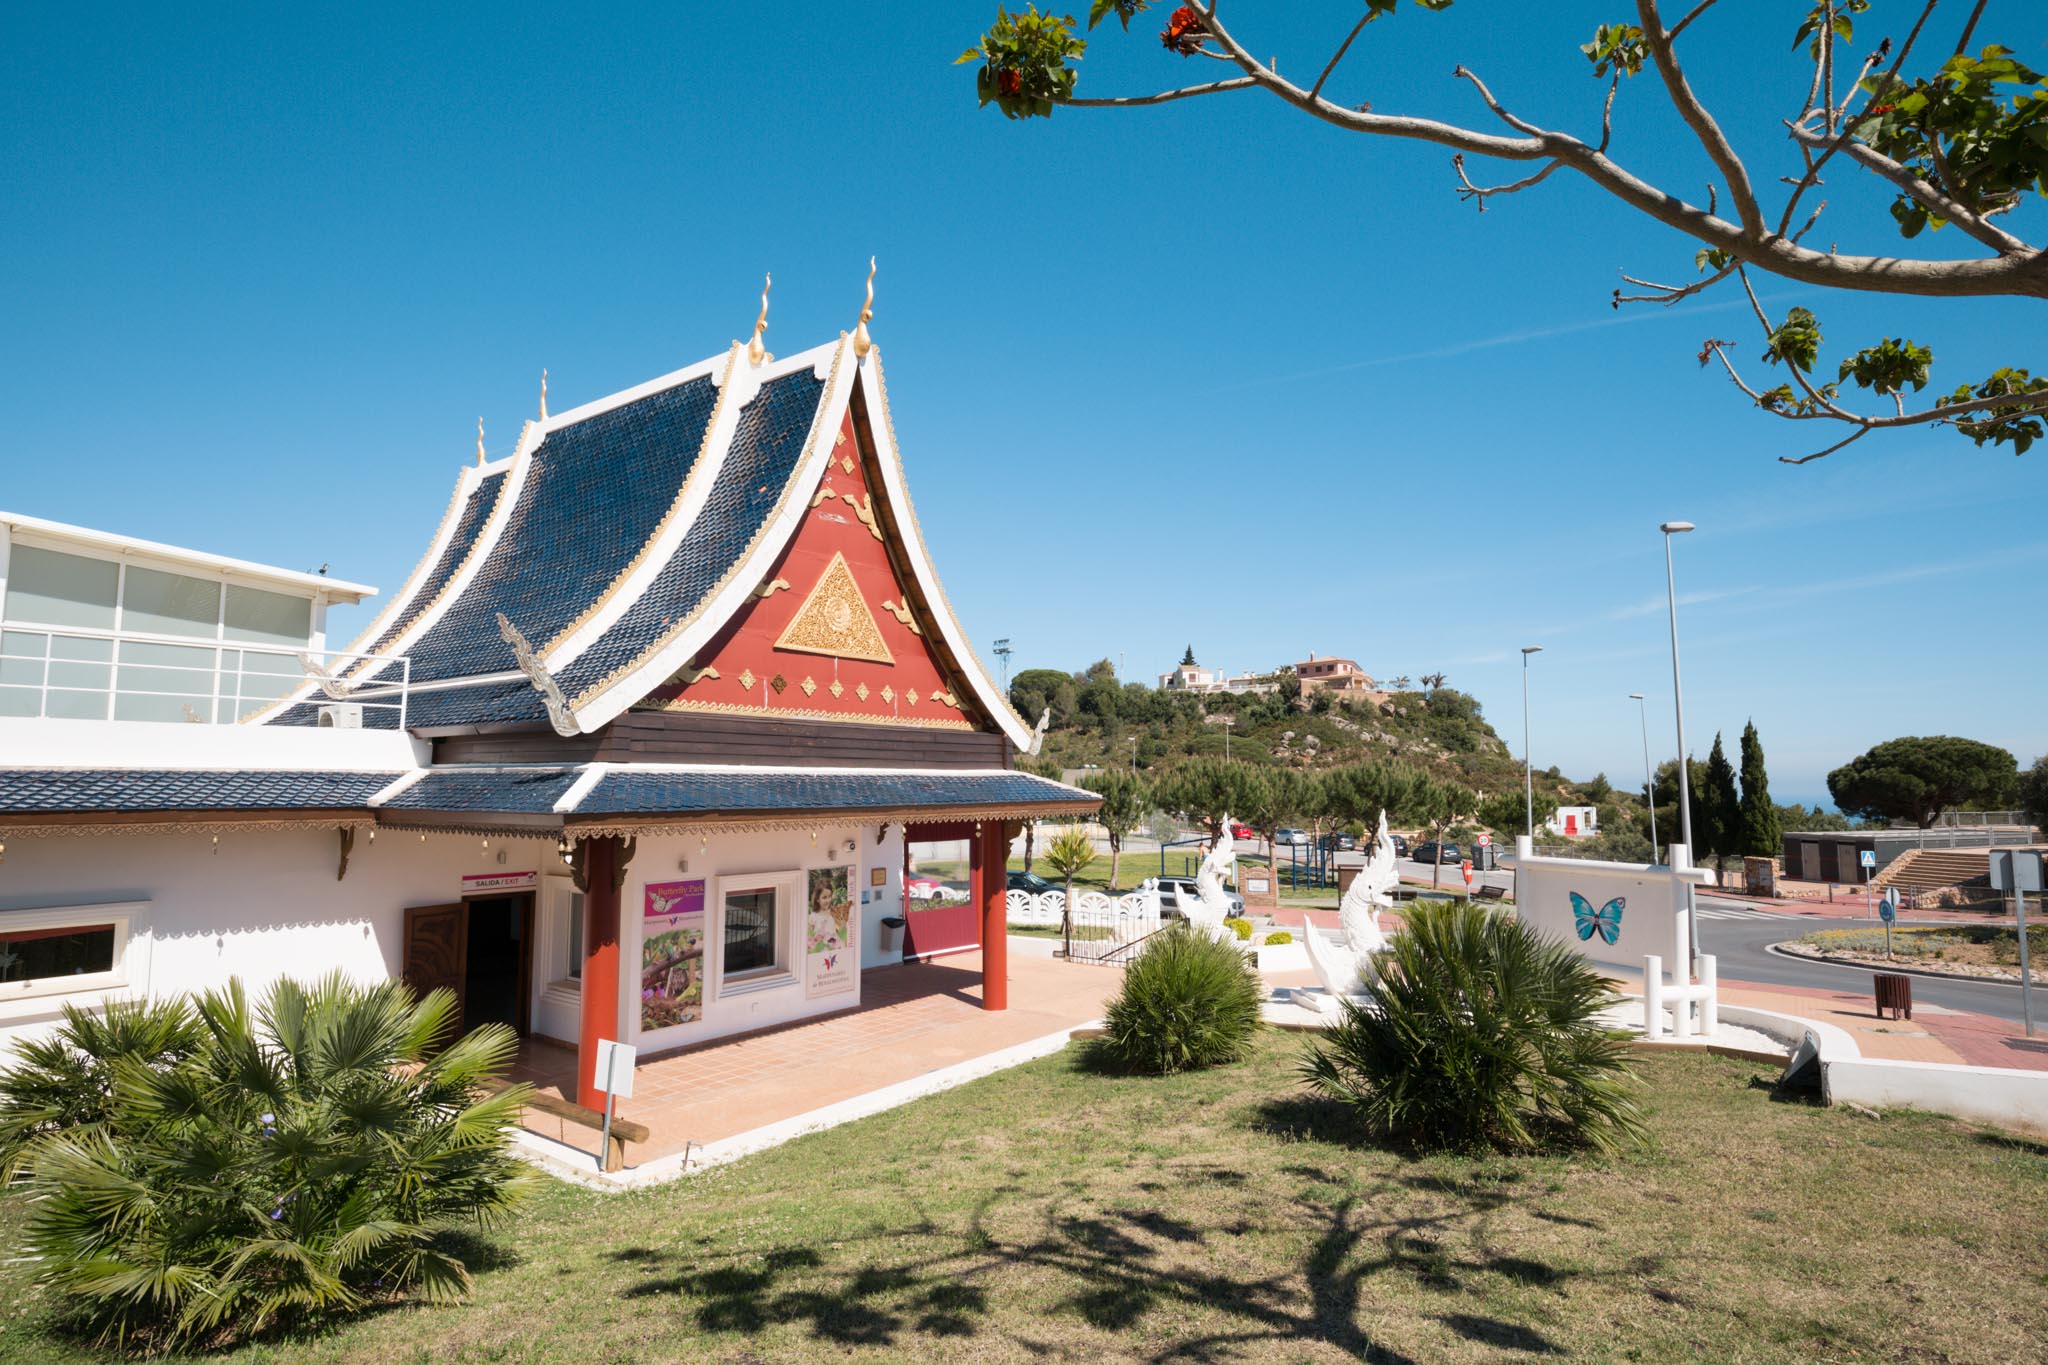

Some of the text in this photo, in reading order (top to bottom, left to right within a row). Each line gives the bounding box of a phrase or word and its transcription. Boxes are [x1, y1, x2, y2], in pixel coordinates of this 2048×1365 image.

[475, 879, 500, 887] SALIDA
[658, 884, 704, 897] Butterfly Park
